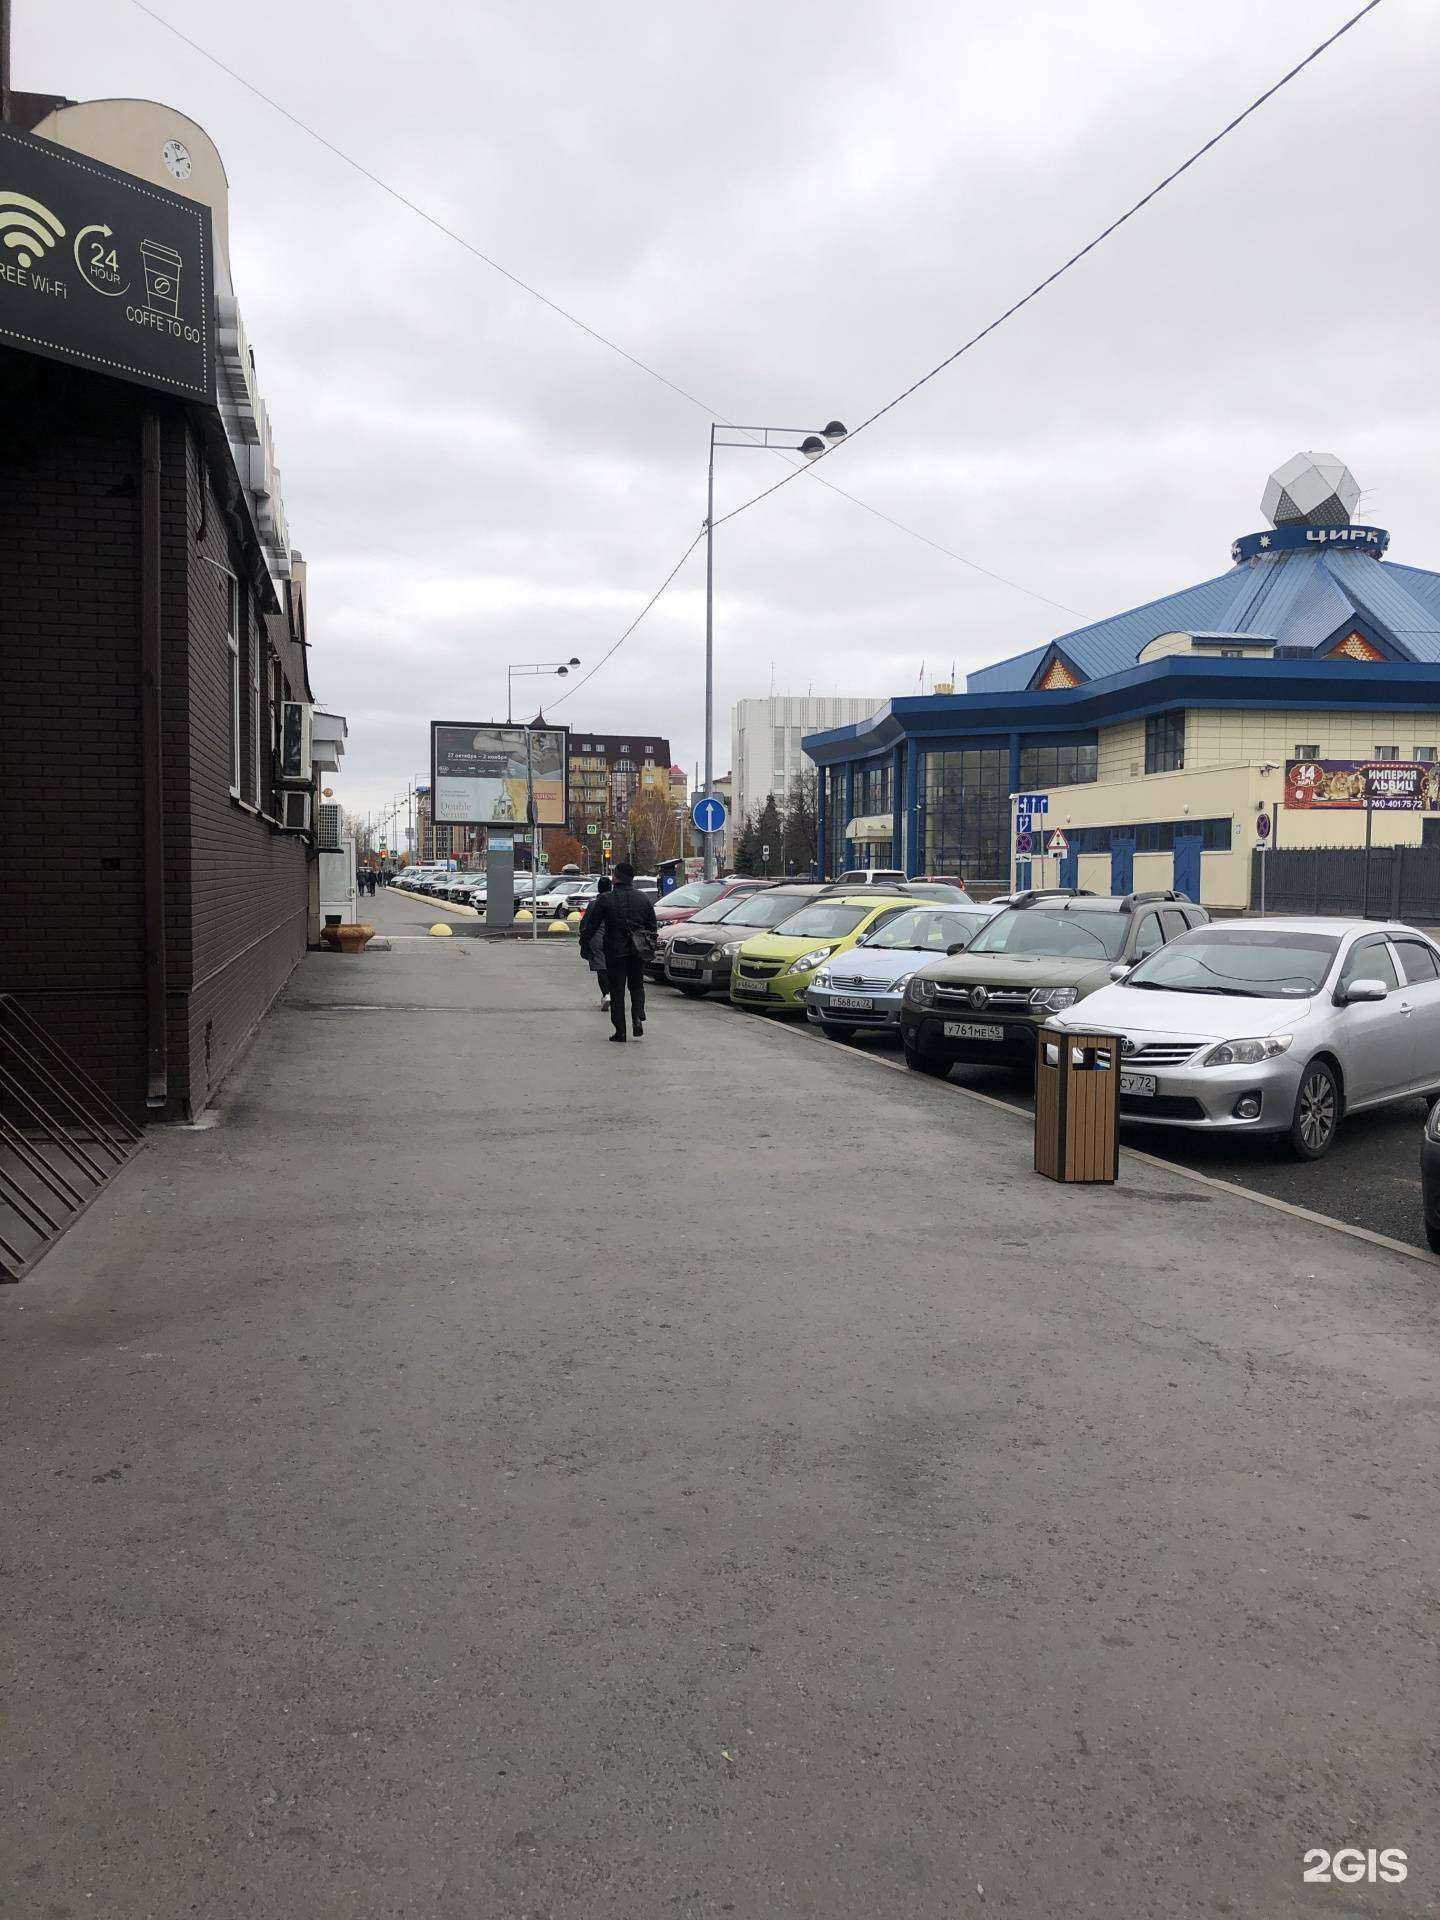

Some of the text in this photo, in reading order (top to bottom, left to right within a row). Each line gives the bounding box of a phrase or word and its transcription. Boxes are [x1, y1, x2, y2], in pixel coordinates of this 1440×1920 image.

[90, 243, 119, 272] 24
[90, 267, 121, 285] HOUR
[31, 272, 68, 300] Wi-Fi
[126, 306, 200, 344] COFFE TO GO
[1306, 530, 1378, 543] ЦИРК
[1299, 765, 1315, 780] 14
[1368, 769, 1417, 780] ИМПЕРИЯ
[1371, 780, 1414, 791] ЛЬВИЦ
[990, 1026, 1000, 1036] 45
[1137, 1076, 1151, 1088] 72
